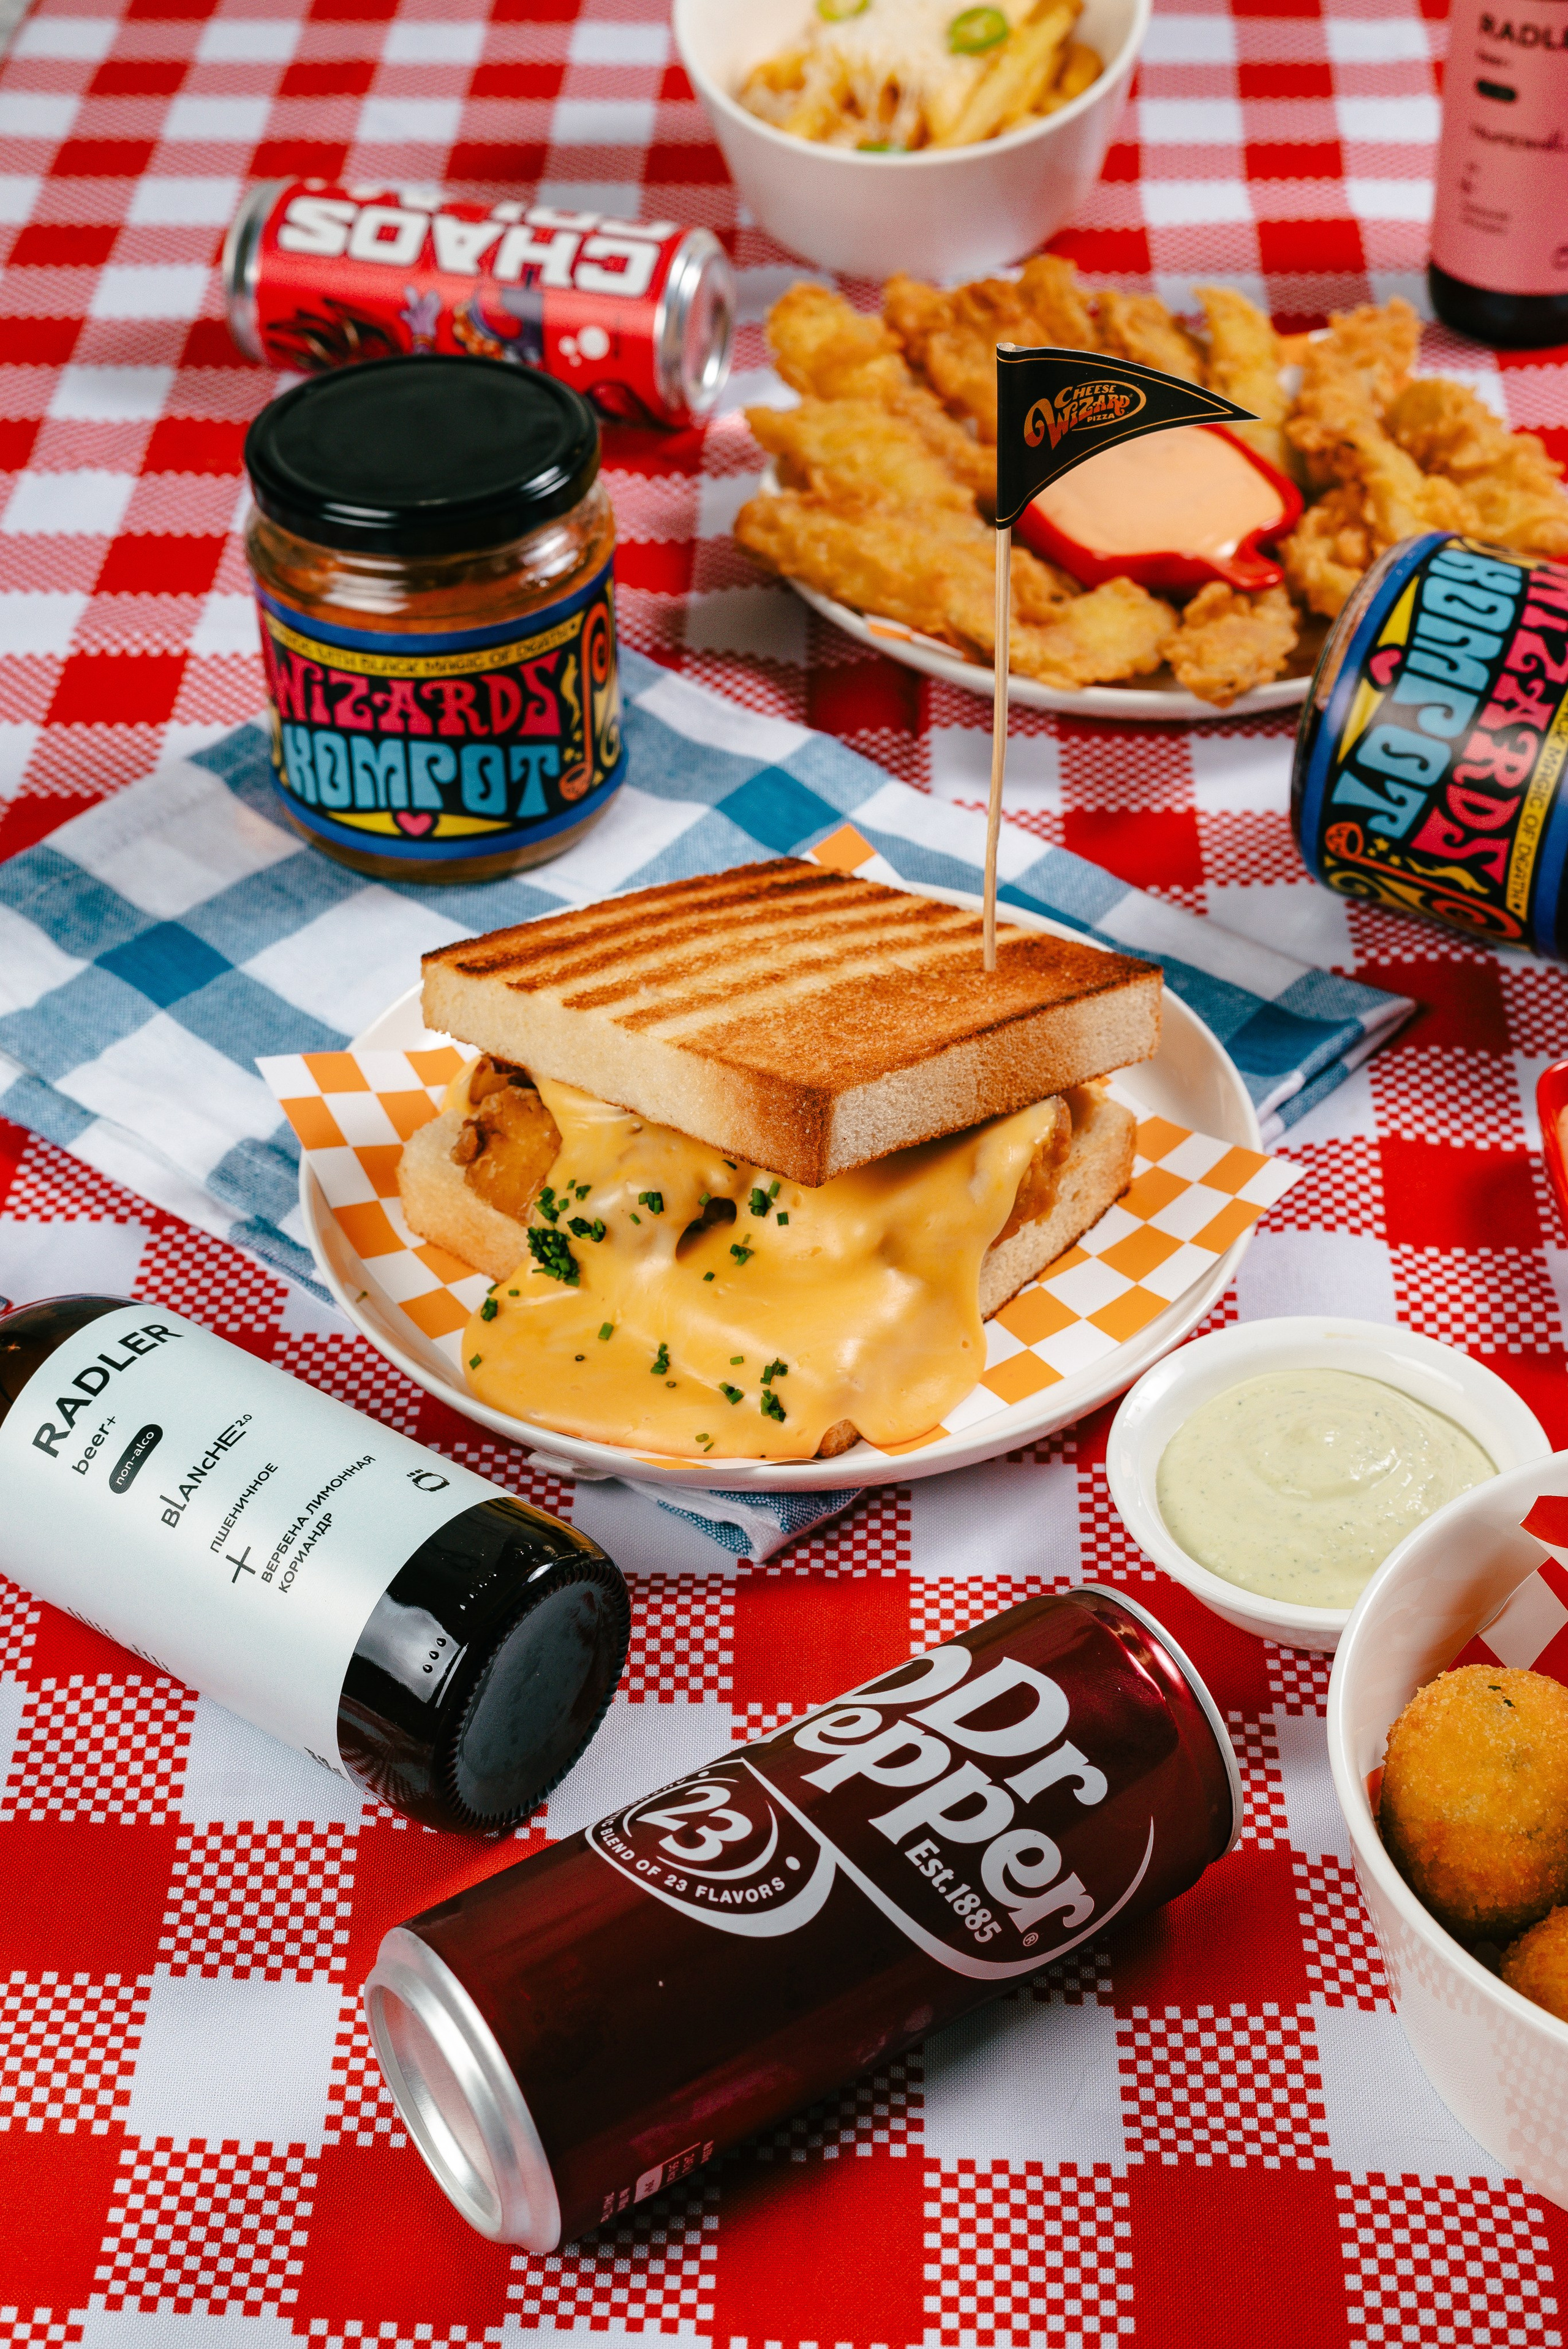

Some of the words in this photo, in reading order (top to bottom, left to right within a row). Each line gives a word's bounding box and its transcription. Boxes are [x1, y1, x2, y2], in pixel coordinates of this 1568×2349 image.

[1479, 12, 1568, 51] RADL
[277, 195, 660, 298] CHAOS
[1054, 384, 1117, 409] CHEESE
[1087, 413, 1116, 423] PIZZA
[424, 653, 484, 673] MAGIC
[489, 648, 510, 666] OF
[1331, 549, 1523, 839] KOMPOT
[283, 724, 560, 818] KOMPOT
[1530, 745, 1561, 809] MAGIC
[1522, 813, 1538, 842] OF
[1511, 843, 1532, 899] DEATH
[32, 1324, 184, 1458] RADLER
[72, 1416, 117, 1475] beer+
[116, 1430, 155, 1485] non-alco
[210, 1463, 279, 1553] ПШЕНИЧНОЕ
[261, 1515, 307, 1583] ВЕРБЕНА
[306, 1455, 376, 1515] ЛИМОННАЯ
[279, 1512, 333, 1593] КОРИАНДР
[906, 1656, 1107, 1805] Dr
[636, 1785, 753, 1861] 23
[743, 1645, 1095, 1933] Pepper
[600, 1828, 635, 1860] BLEND
[636, 1860, 662, 1876] OF
[664, 1874, 688, 1892] 23
[695, 1877, 785, 1904] FLAVORS
